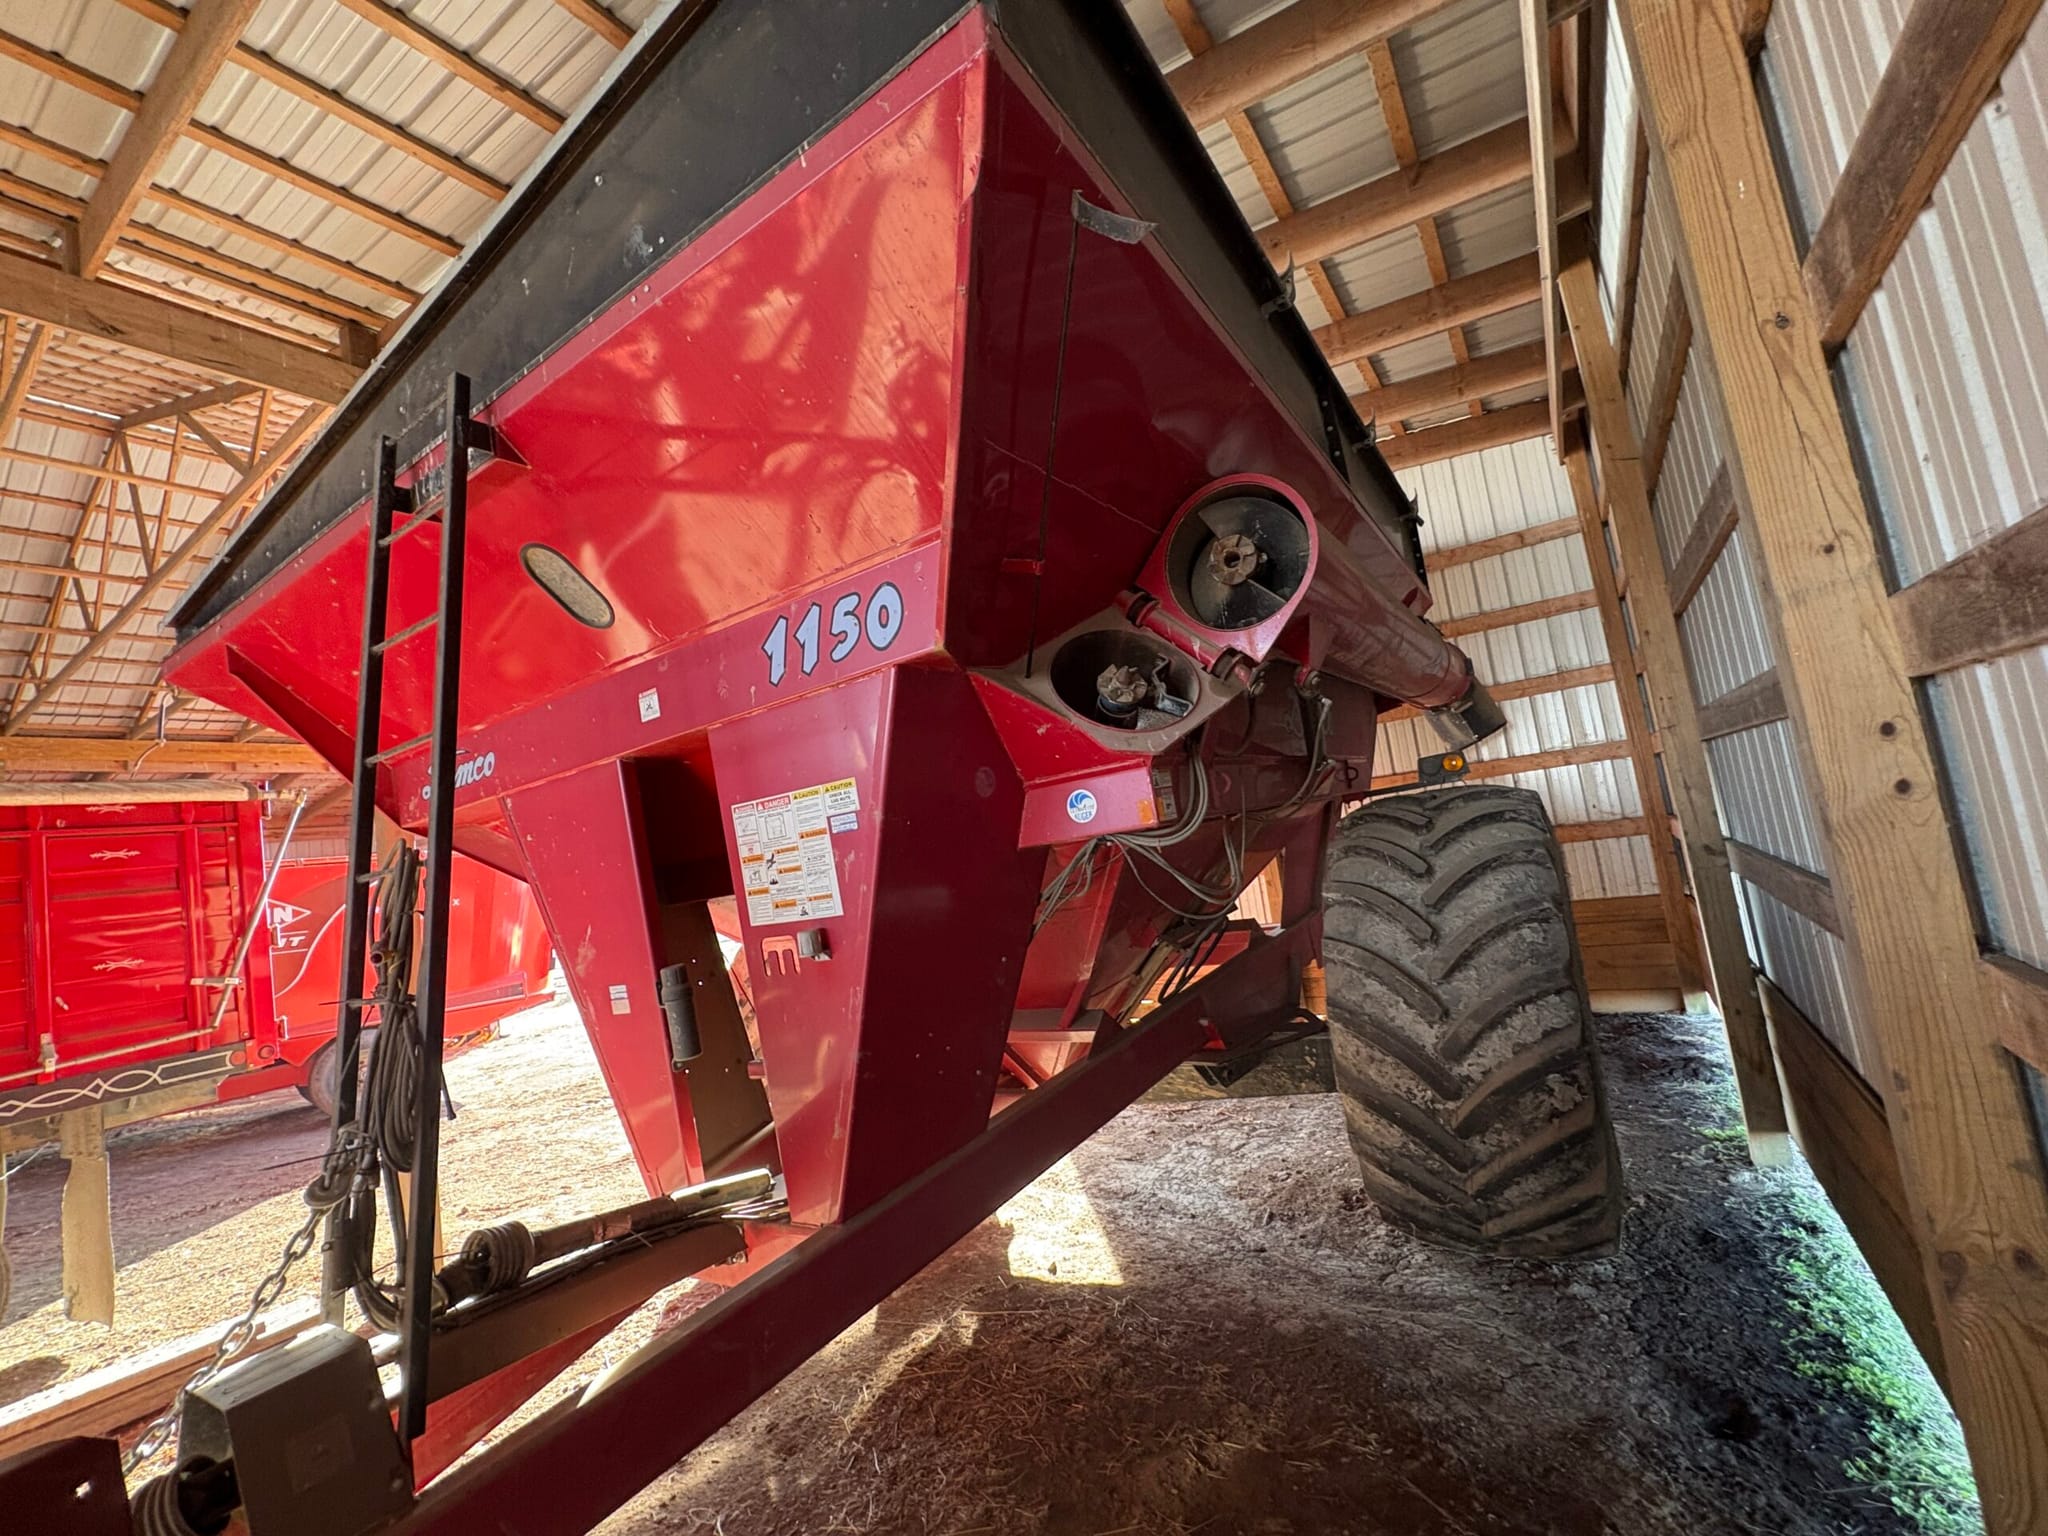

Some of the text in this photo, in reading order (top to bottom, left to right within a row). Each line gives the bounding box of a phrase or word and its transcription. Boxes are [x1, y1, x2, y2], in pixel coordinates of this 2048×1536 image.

[761, 581, 904, 687] 1150
[422, 750, 495, 800] mco
[764, 797, 789, 809] DANGER
